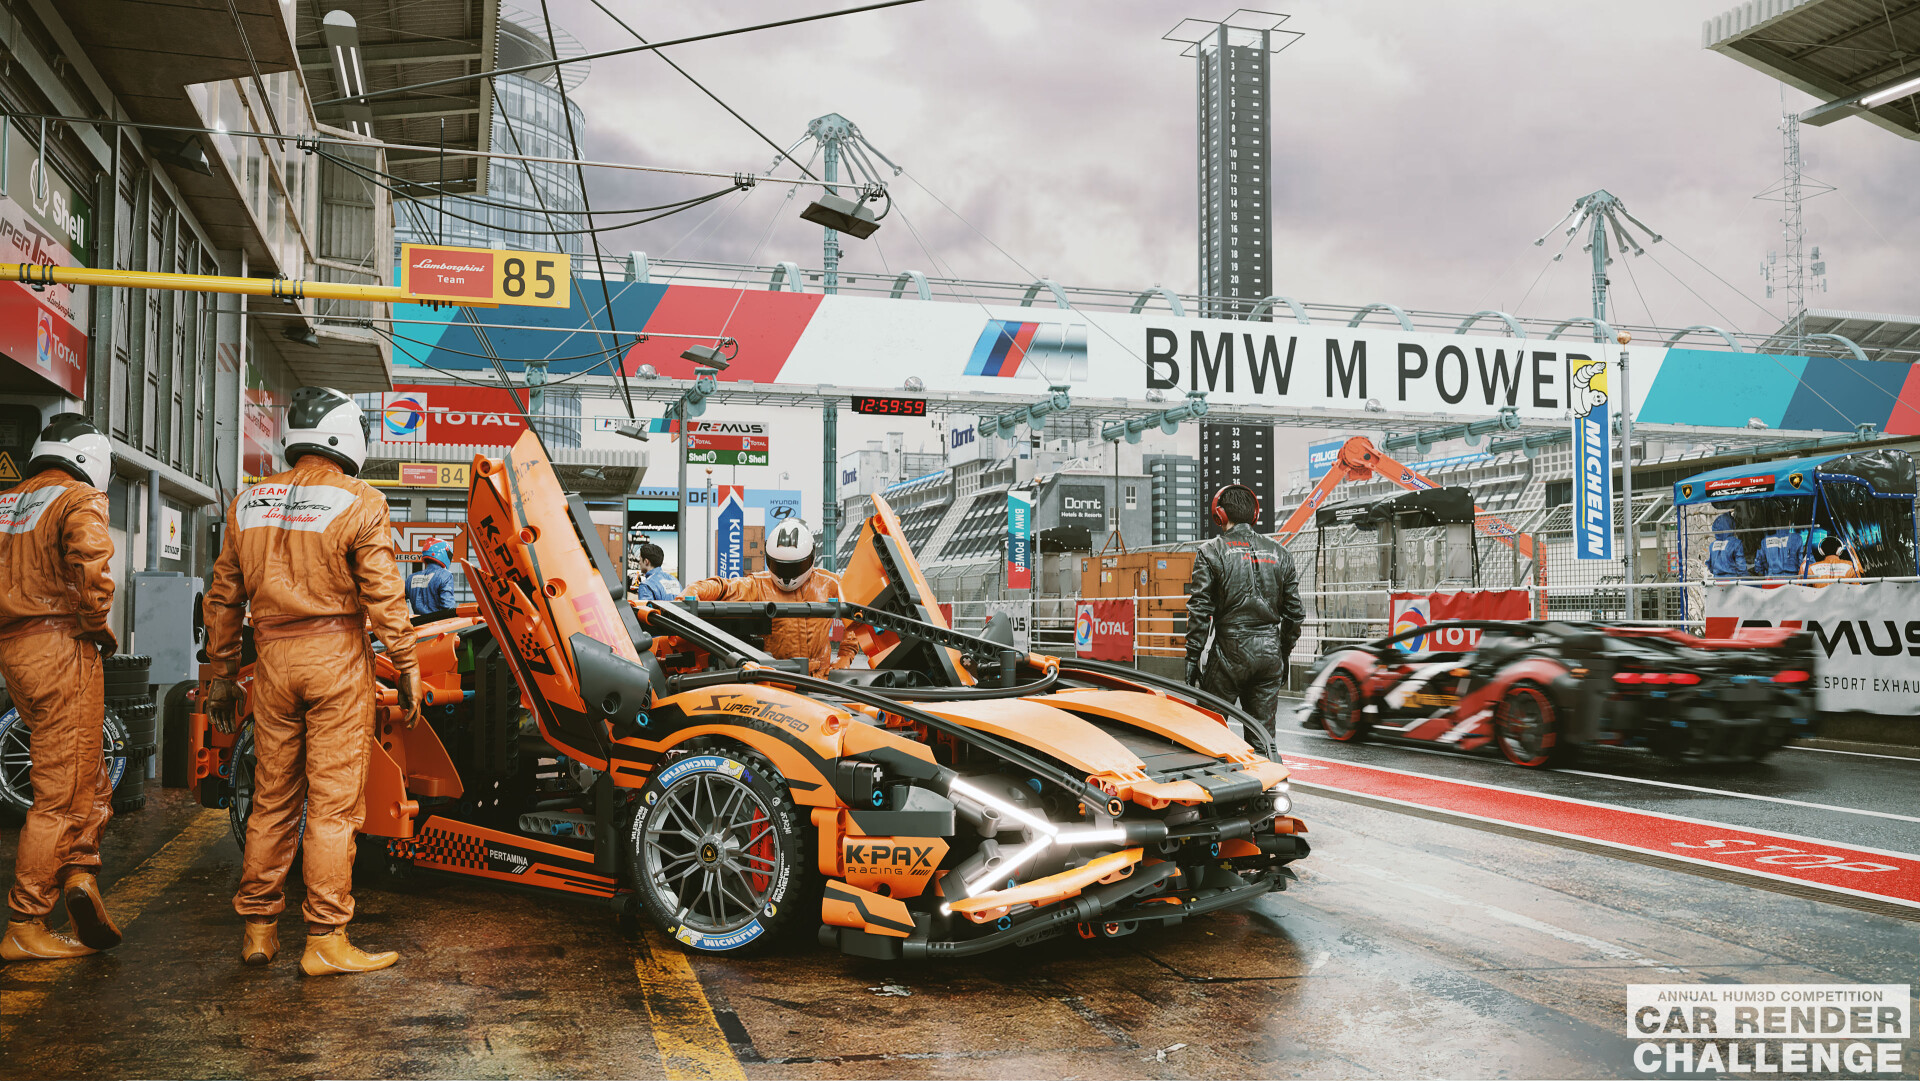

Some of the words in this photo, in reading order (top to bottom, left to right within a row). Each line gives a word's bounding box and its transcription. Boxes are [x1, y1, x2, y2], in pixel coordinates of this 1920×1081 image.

[1230, 49, 1236, 57] 2
[1230, 62, 1236, 70] 3
[1230, 87, 1236, 95] 5
[1230, 99, 1236, 107] 6
[1231, 112, 1236, 120] 7
[1231, 124, 1236, 132] 8
[1231, 137, 1236, 145] 9
[1230, 149, 1238, 157] 10
[1230, 162, 1237, 170] 11
[1230, 174, 1238, 183] 12
[1230, 187, 1238, 195] 13
[1230, 200, 1238, 208] 14
[53, 190, 84, 249] Shell
[1230, 212, 1238, 220] 15
[1230, 225, 1239, 233] 16
[1230, 237, 1238, 245] 17
[1230, 250, 1239, 258] 18
[413, 258, 485, 273] Lamborghini
[1230, 262, 1239, 271] 19
[437, 275, 465, 284] Team
[503, 258, 555, 299] 85
[1230, 275, 1239, 283] 20
[1232, 288, 1239, 296] 21
[47, 290, 75, 320] Lamborghini
[53, 333, 80, 370] TOTAL
[1145, 328, 1297, 396] BMW
[1326, 339, 1367, 400] M
[860, 399, 924, 414] 12:59:59
[428, 407, 520, 426] TOTAL
[698, 422, 763, 433] REMUS
[1232, 427, 1240, 436] 32
[1232, 440, 1240, 448] 33
[688, 453, 706, 461] Shell
[749, 455, 766, 463] Shell
[1232, 453, 1240, 461] 34
[1232, 466, 1240, 474] 35
[441, 467, 463, 484] 84
[1586, 419, 1603, 556] MICHELIN
[1709, 480, 1741, 488] Lamborghini
[252, 488, 287, 496] TEAM
[1015, 509, 1024, 529] BMW
[631, 521, 675, 531] Lamborghini
[1015, 530, 1024, 539] M
[165, 544, 179, 555] DUNLOP
[1015, 541, 1024, 572] POWER
[1093, 618, 1129, 635] TOTAL
[1824, 676, 1867, 691] SPORT
[489, 849, 528, 866] PERTAMINA
[846, 845, 934, 872] K-PAX
[1671, 839, 1900, 872] STOP
